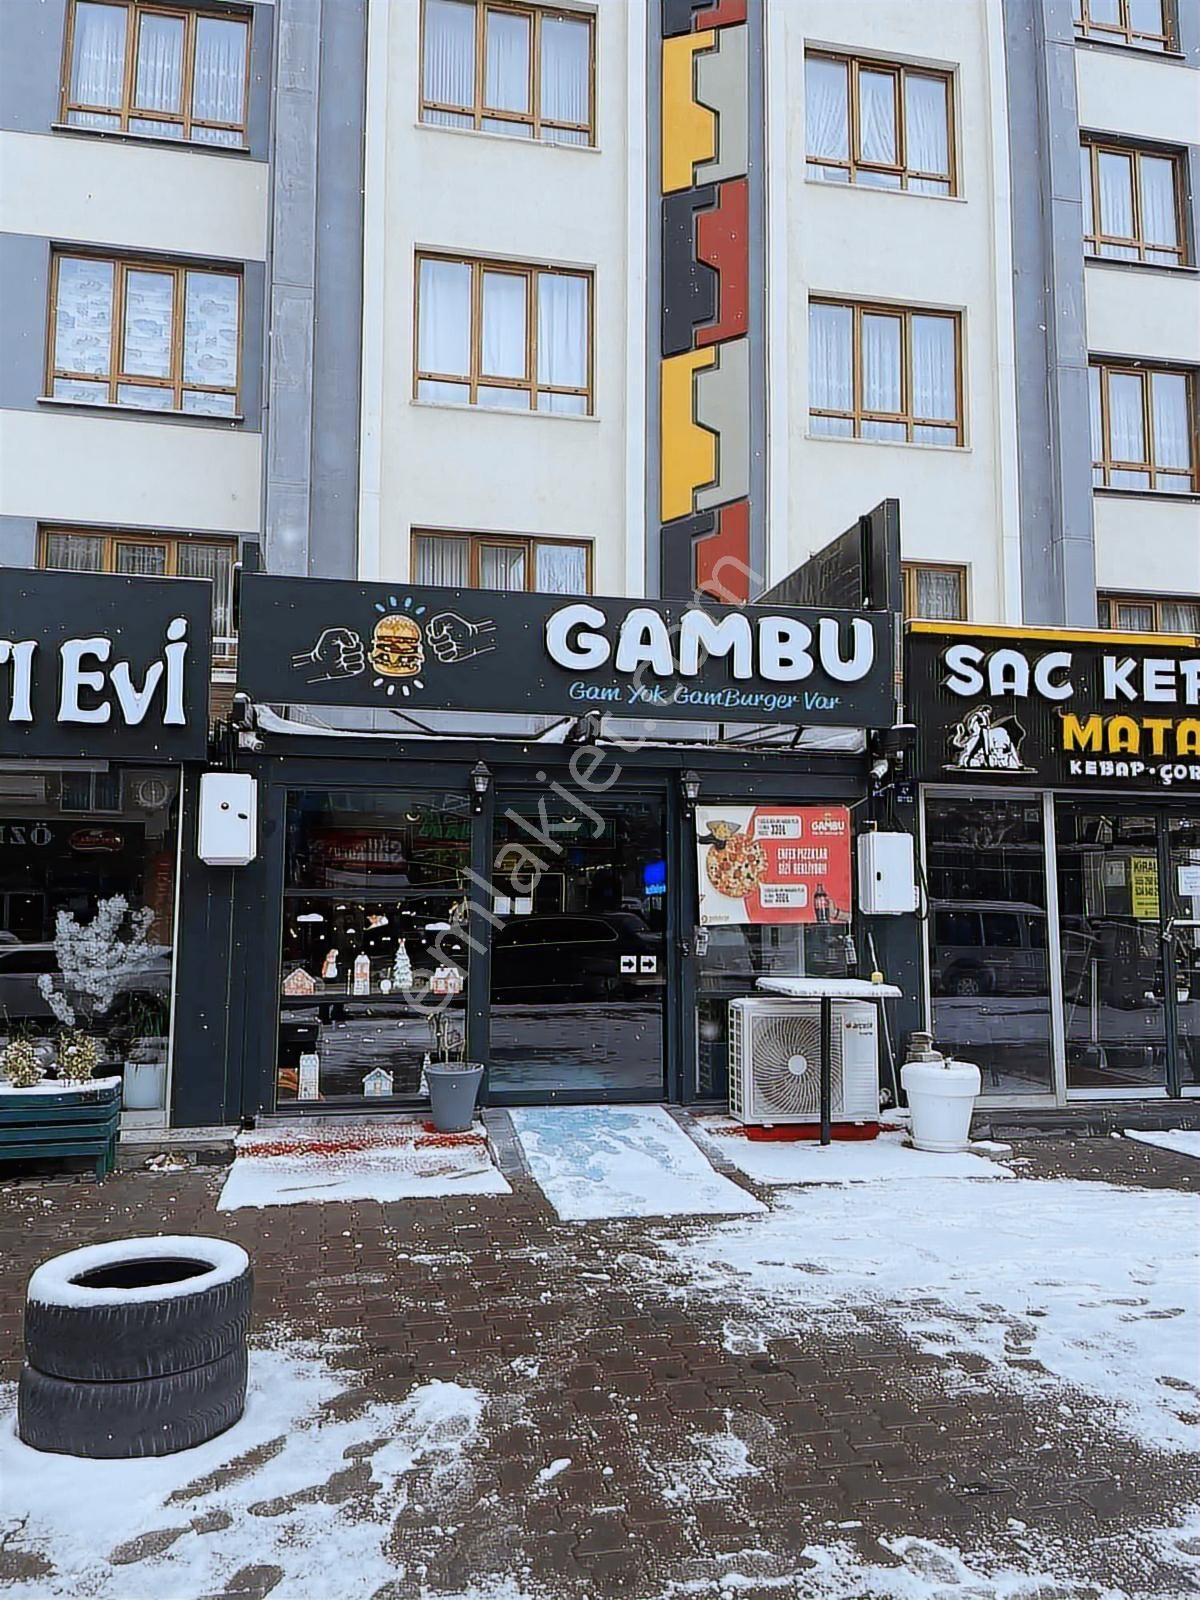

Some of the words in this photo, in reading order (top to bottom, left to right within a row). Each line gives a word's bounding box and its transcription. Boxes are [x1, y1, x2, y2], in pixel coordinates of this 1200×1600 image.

[546, 604, 874, 682] GAMBU
[945, 644, 1074, 700] SAC
[569, 682, 622, 701] Gam
[626, 684, 669, 704] Yok
[673, 684, 799, 712] GamBurger
[804, 691, 841, 710] Var
[1062, 714, 1200, 755] MATA
[1070, 760, 1144, 777] KEBAP
[811, 820, 845, 832] GAMBU
